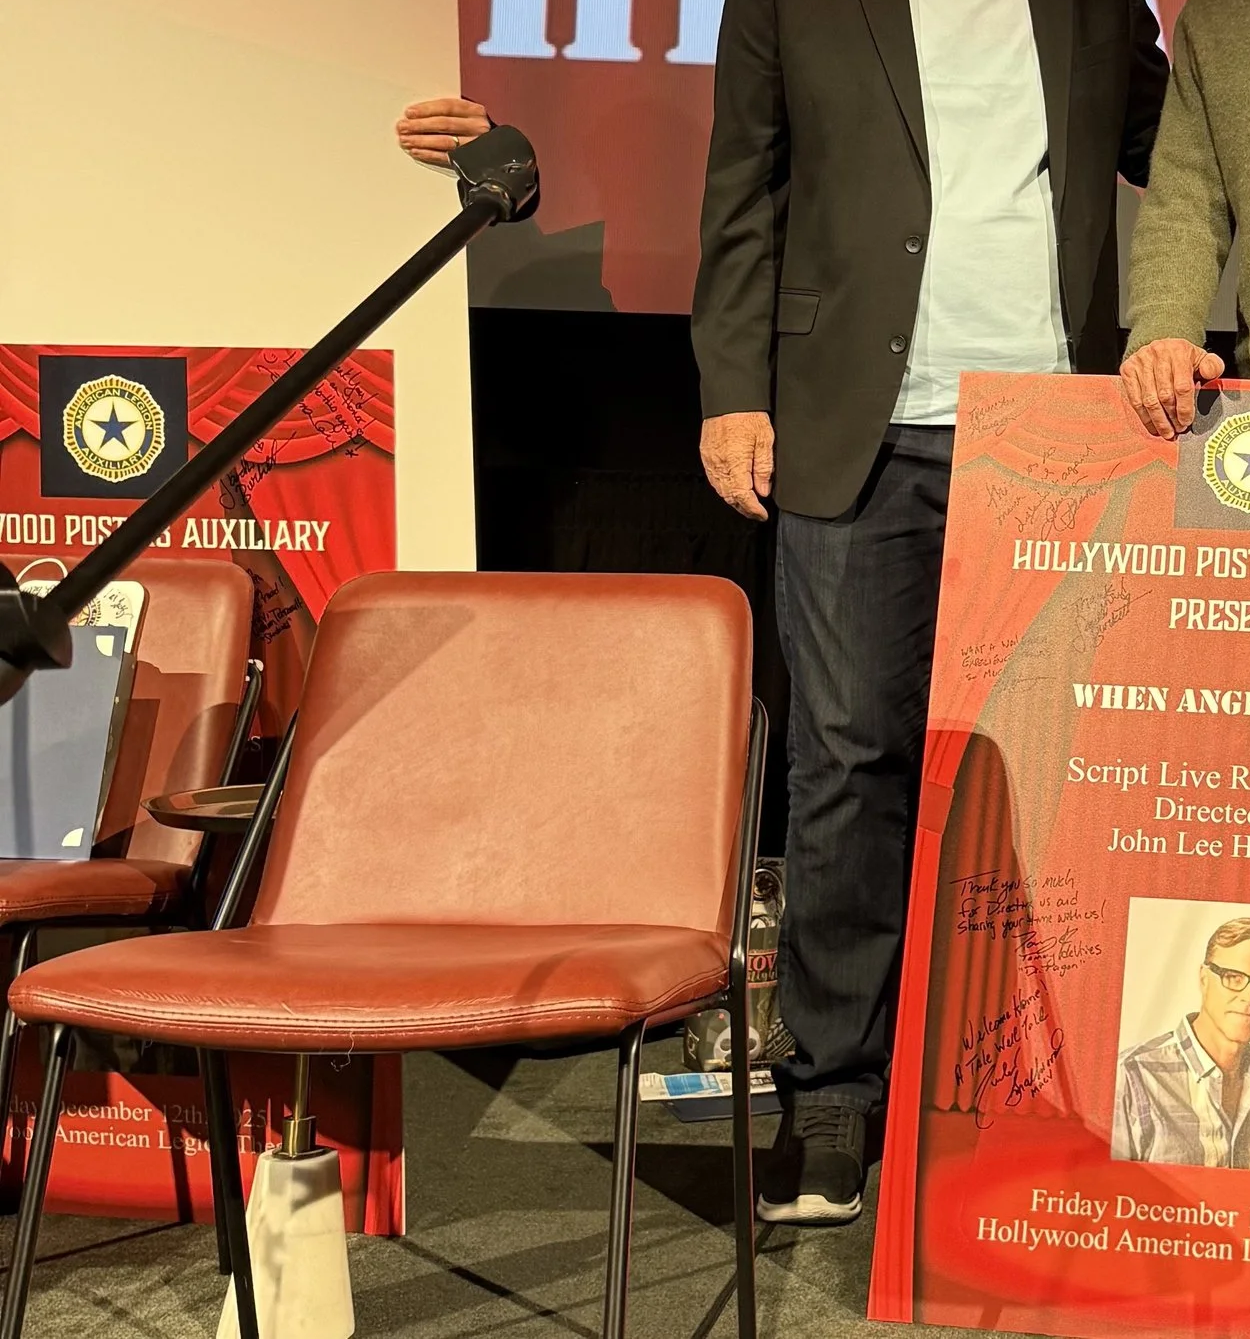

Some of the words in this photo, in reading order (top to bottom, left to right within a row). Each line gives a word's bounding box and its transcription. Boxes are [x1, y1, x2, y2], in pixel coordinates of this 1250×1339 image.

[75, 388, 121, 429] AMERICAN
[124, 391, 153, 430] LEGION
[81, 449, 144, 469] AUXILIARY
[0, 513, 55, 545] OOD
[182, 517, 331, 551] AUXILIARY
[1012, 539, 1186, 576] HOLLYWOOD
[1072, 682, 1169, 711] WHEN
[1067, 756, 1150, 792] Script
[1157, 761, 1221, 789] Live
[1107, 827, 1168, 855] John
[1175, 831, 1223, 857] Lee
[55, 1123, 151, 1149] American
[157, 1129, 211, 1157] Legi
[1029, 1188, 1109, 1224] Friday
[1114, 1195, 1240, 1228] December
[976, 1216, 1110, 1252] Hollywood
[1114, 1228, 1233, 1261] American
